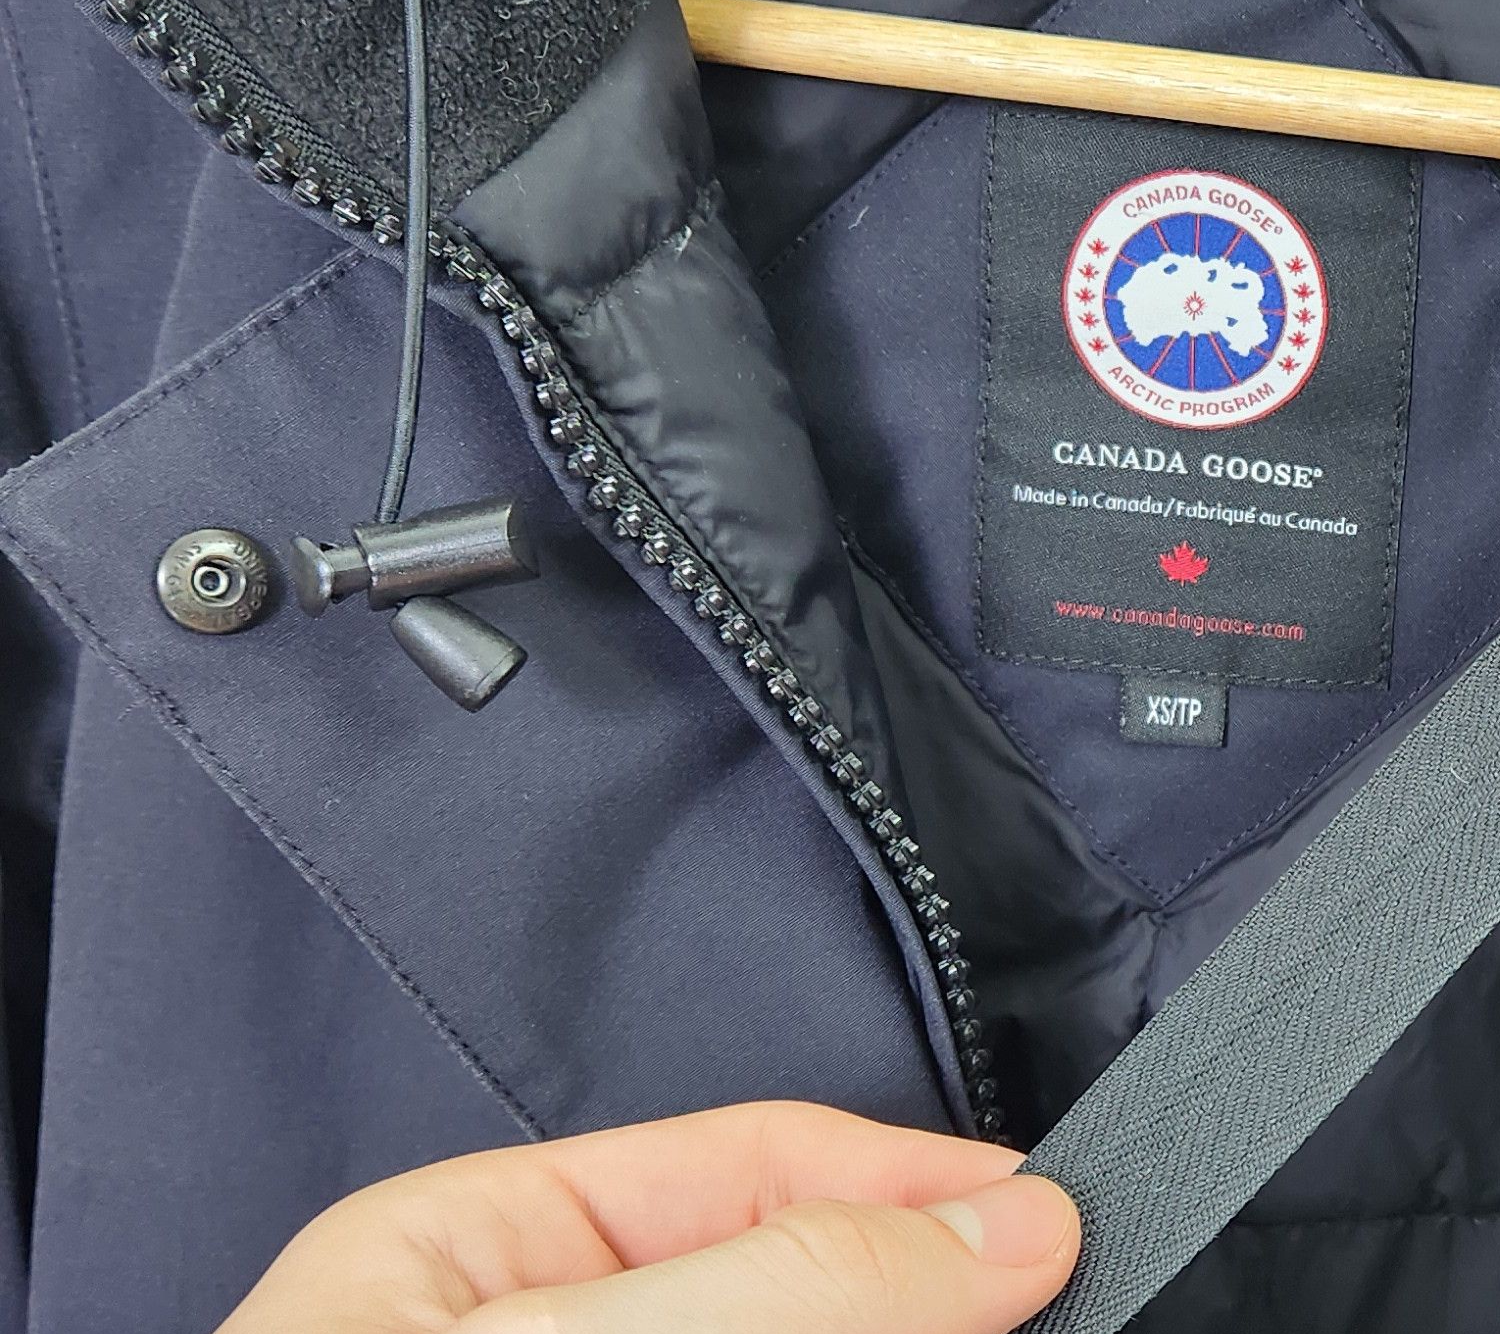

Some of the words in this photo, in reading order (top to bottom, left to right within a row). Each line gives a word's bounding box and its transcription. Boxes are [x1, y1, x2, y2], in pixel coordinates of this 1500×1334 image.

[1122, 185, 1202, 219] CANADA
[1108, 365, 1175, 412] ARCTIC
[1179, 382, 1275, 418] PROGRAM
[1053, 442, 1189, 475] CANADA
[1013, 484, 1067, 507] Made
[1071, 488, 1089, 508] in
[1258, 511, 1281, 527] au
[1285, 512, 1358, 536] Canada
[1146, 695, 1202, 726] XS/TP
